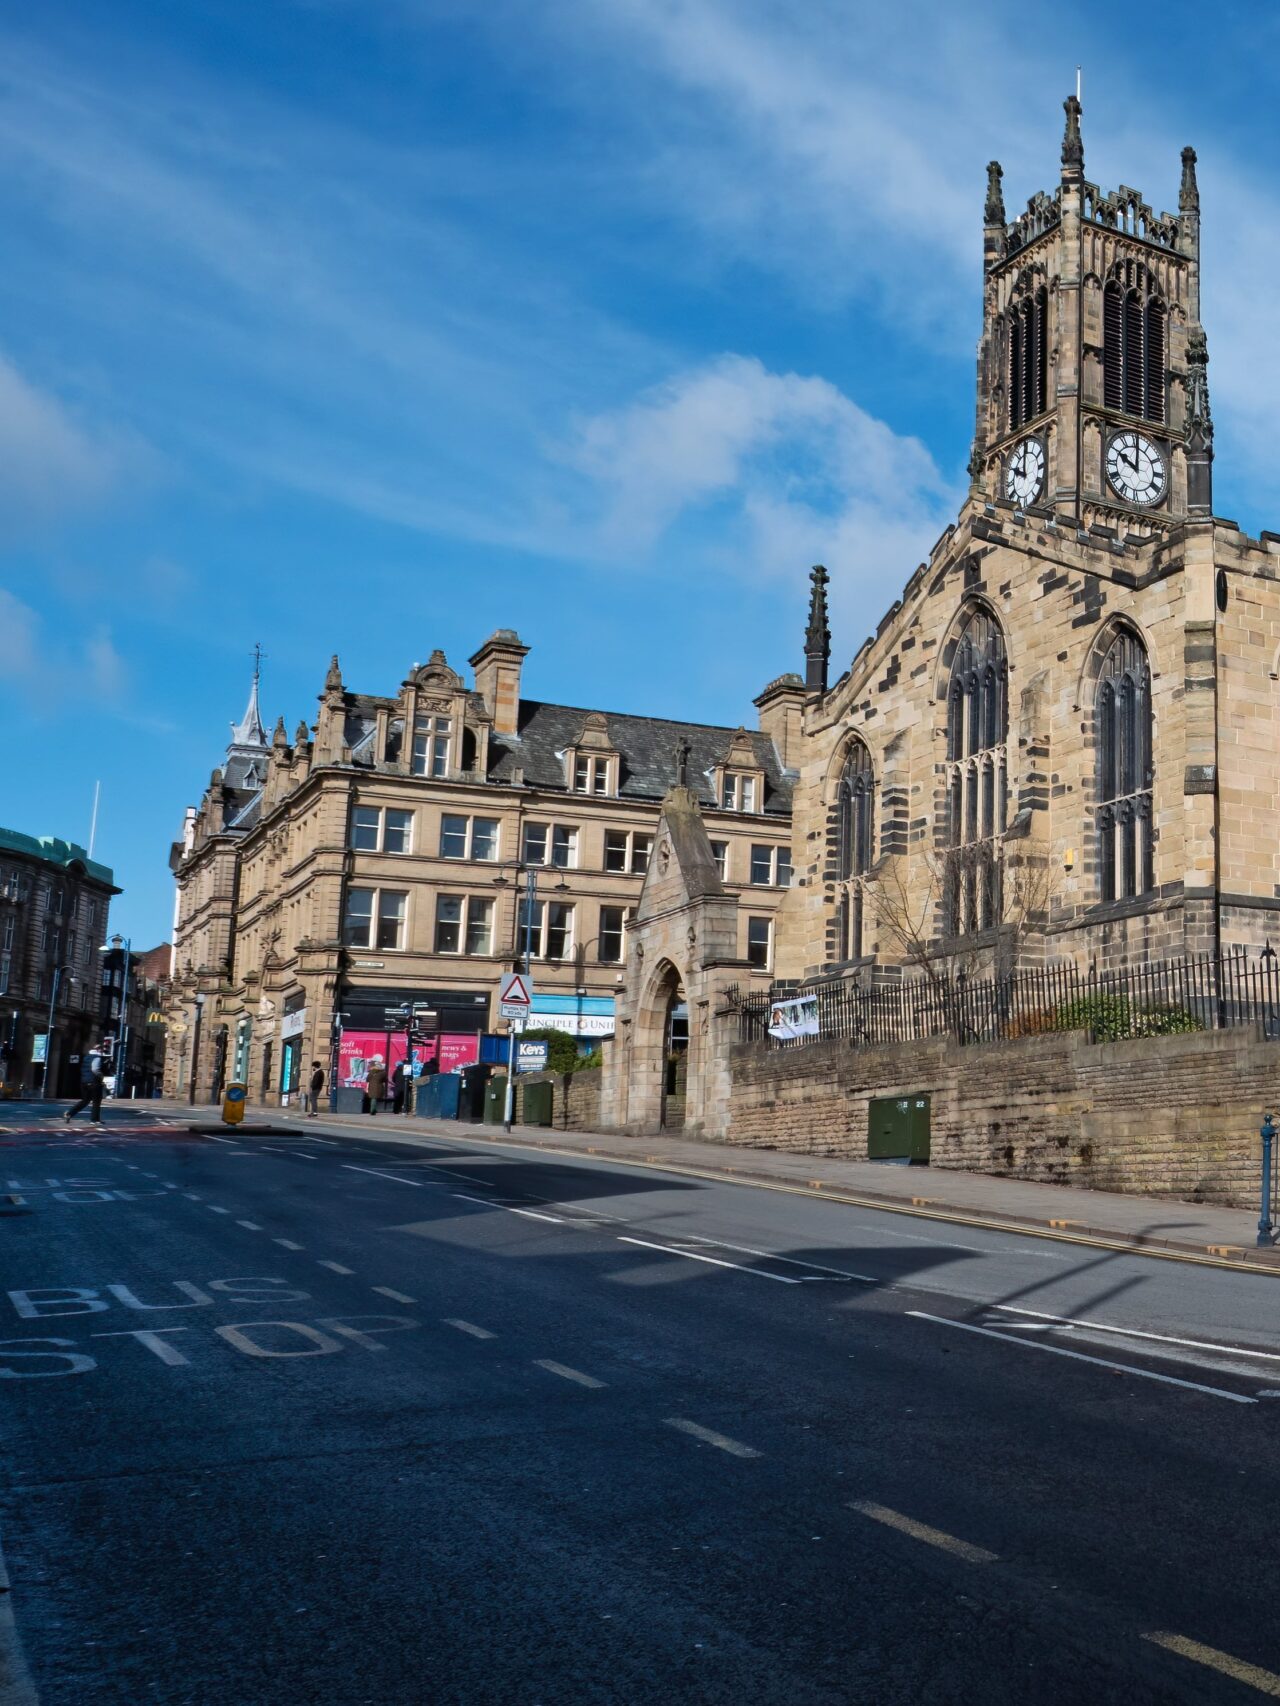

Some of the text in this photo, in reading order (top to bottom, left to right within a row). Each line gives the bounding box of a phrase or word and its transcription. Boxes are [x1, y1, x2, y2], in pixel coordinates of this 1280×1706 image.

[520, 1043, 545, 1055] Keys
[7, 1177, 113, 1190] US
[0, 1190, 168, 1205] TOP
[8, 1277, 311, 1318] BUS
[0, 1315, 422, 1378] STOP
